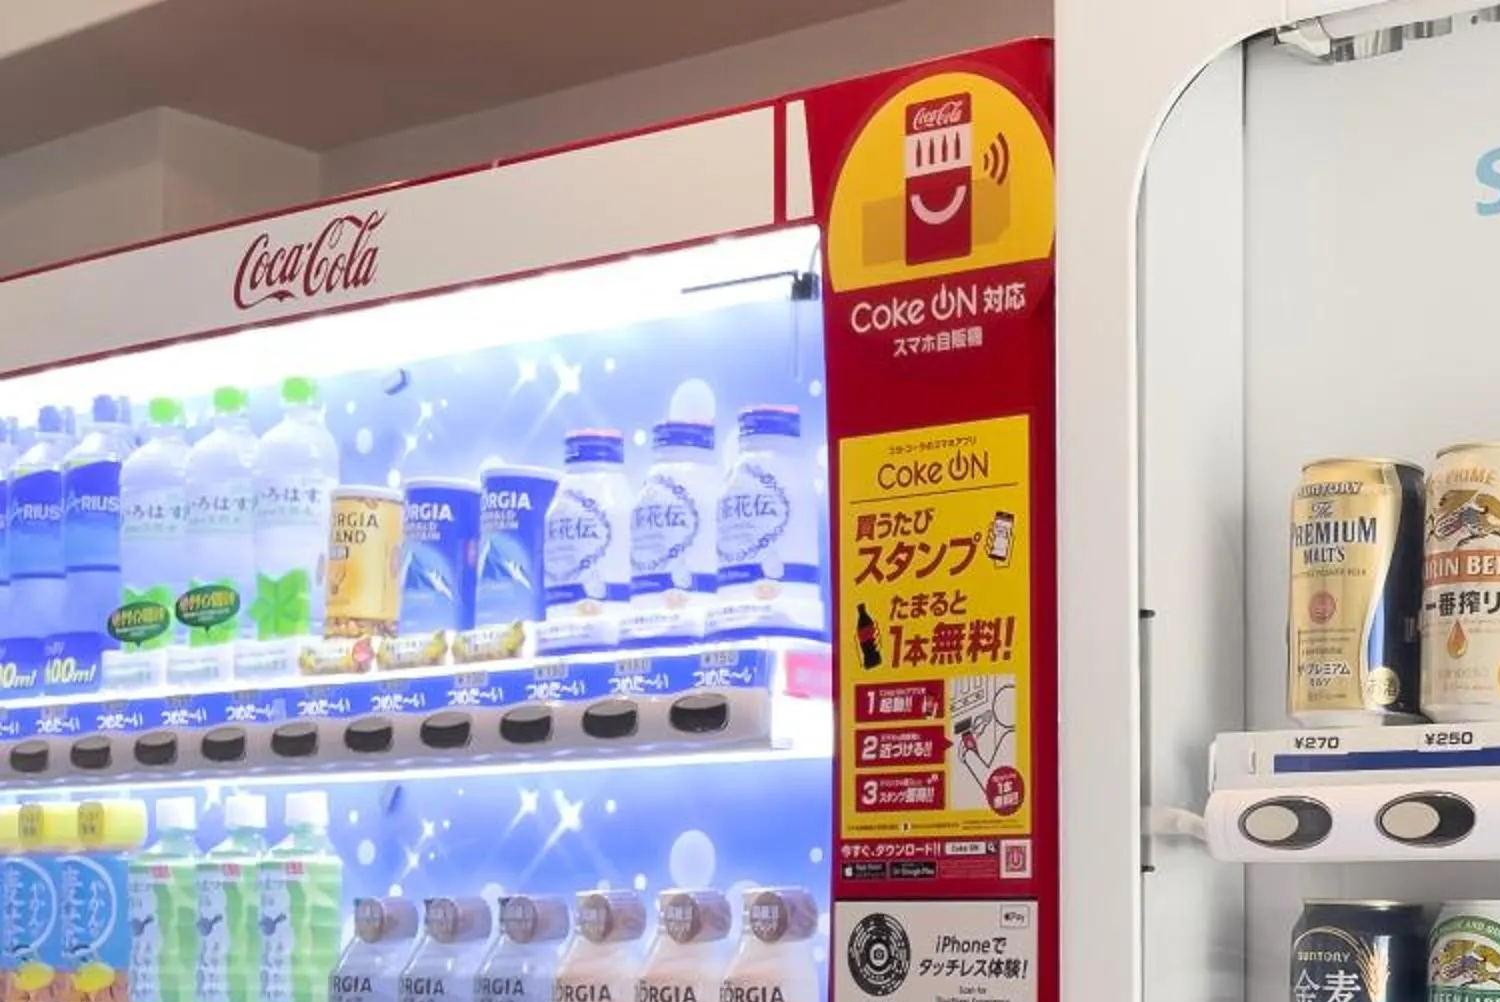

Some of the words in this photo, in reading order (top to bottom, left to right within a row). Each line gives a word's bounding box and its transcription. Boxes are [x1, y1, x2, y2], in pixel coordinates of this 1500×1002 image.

[912, 100, 964, 131] Coca-Cola
[234, 210, 388, 310] Coca-Cola
[851, 297, 925, 333] Coke
[931, 282, 978, 321] ON
[983, 283, 1027, 314] 対応
[893, 326, 984, 357] スマホ自販機
[877, 460, 943, 490] Coke
[948, 451, 990, 482] ON
[856, 508, 935, 541] 買うたび
[855, 532, 982, 585] スタンプ
[889, 590, 968, 621] たまると
[889, 616, 1015, 668] 1本無料!
[1293, 735, 1341, 751] ¥270
[1424, 730, 1474, 747] ¥250
[935, 935, 1008, 955] iPhoneで
[1297, 950, 1350, 963] SUNTORY
[919, 959, 1029, 979] タッチレス体験!
